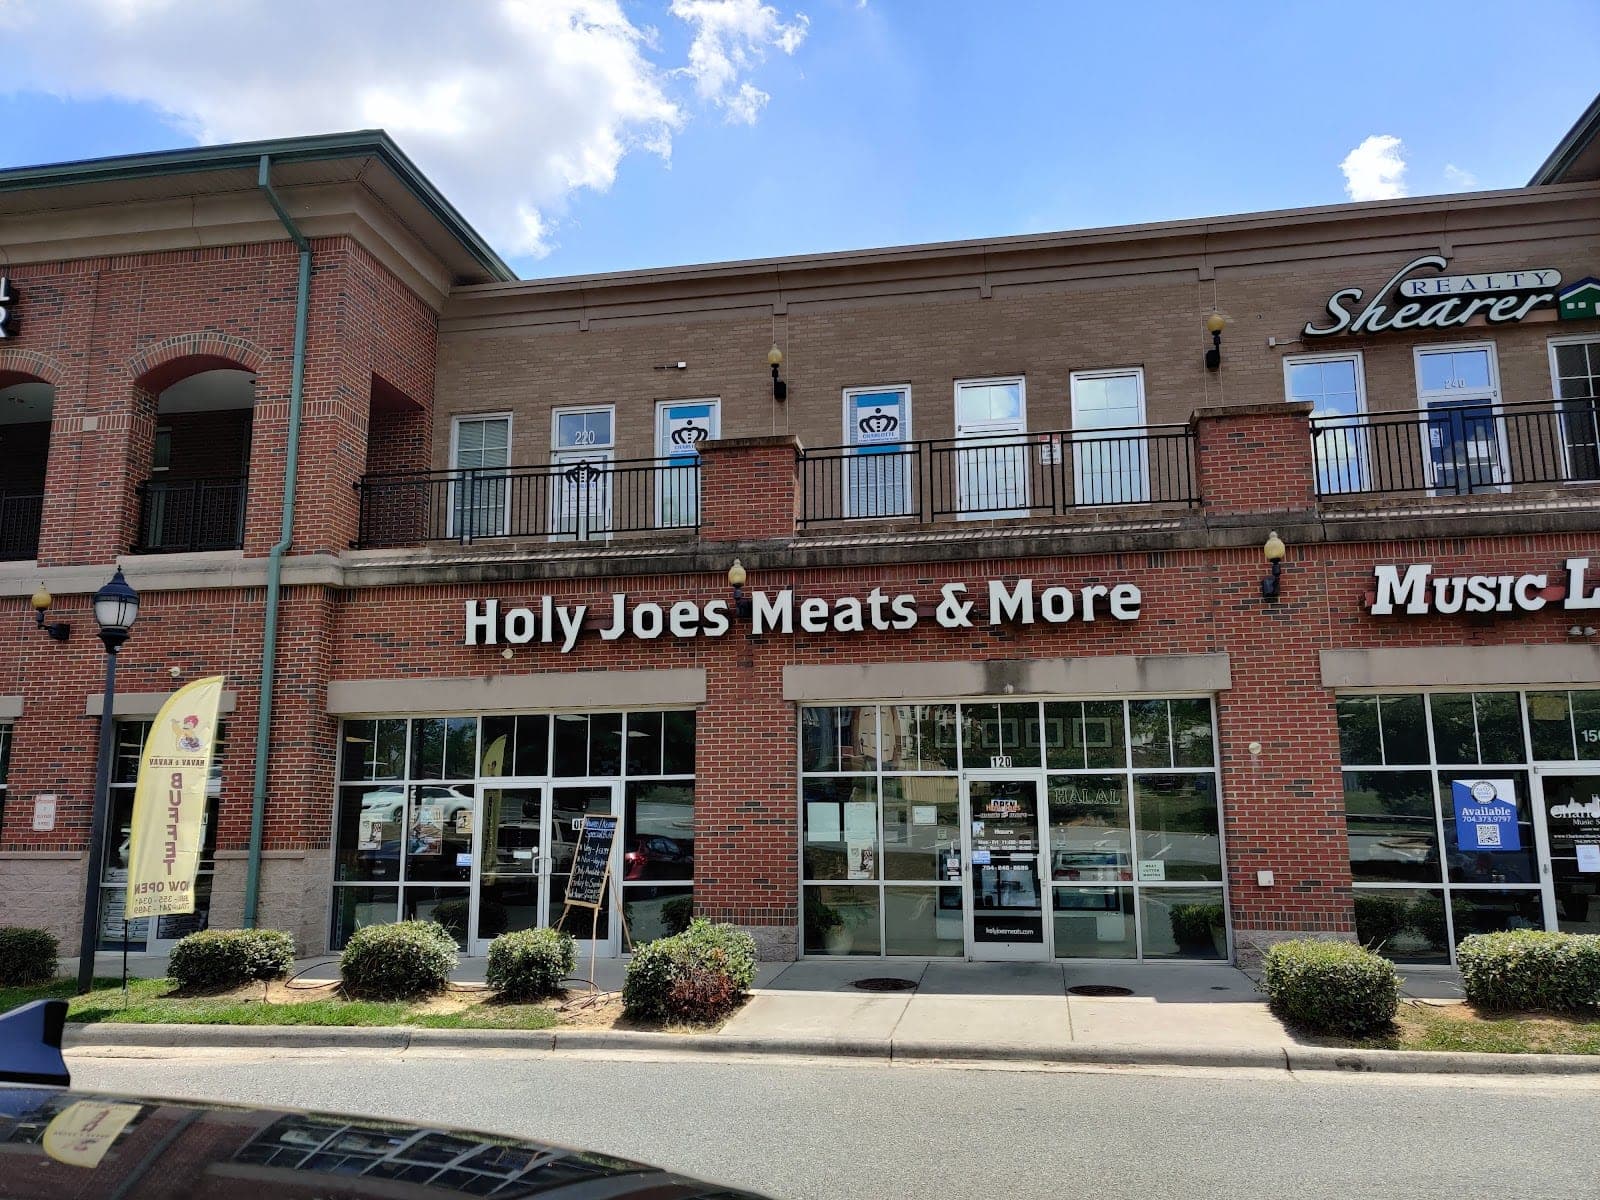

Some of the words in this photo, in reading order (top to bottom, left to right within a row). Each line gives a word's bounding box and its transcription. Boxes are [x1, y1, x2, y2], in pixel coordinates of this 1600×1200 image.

[1411, 271, 1552, 294] REALTY
[1304, 255, 1554, 335] Shearer
[575, 430, 596, 444] 220
[1371, 564, 1547, 615] MUSIC
[464, 594, 587, 653] Holy
[599, 593, 729, 641] Joes
[751, 587, 918, 635] Meats
[935, 582, 975, 629] &
[988, 578, 1141, 625] More
[992, 756, 1012, 768] 120
[1054, 788, 1121, 805] HALAL
[1462, 806, 1511, 816] Available
[1463, 815, 1512, 823] 704.373.9797
